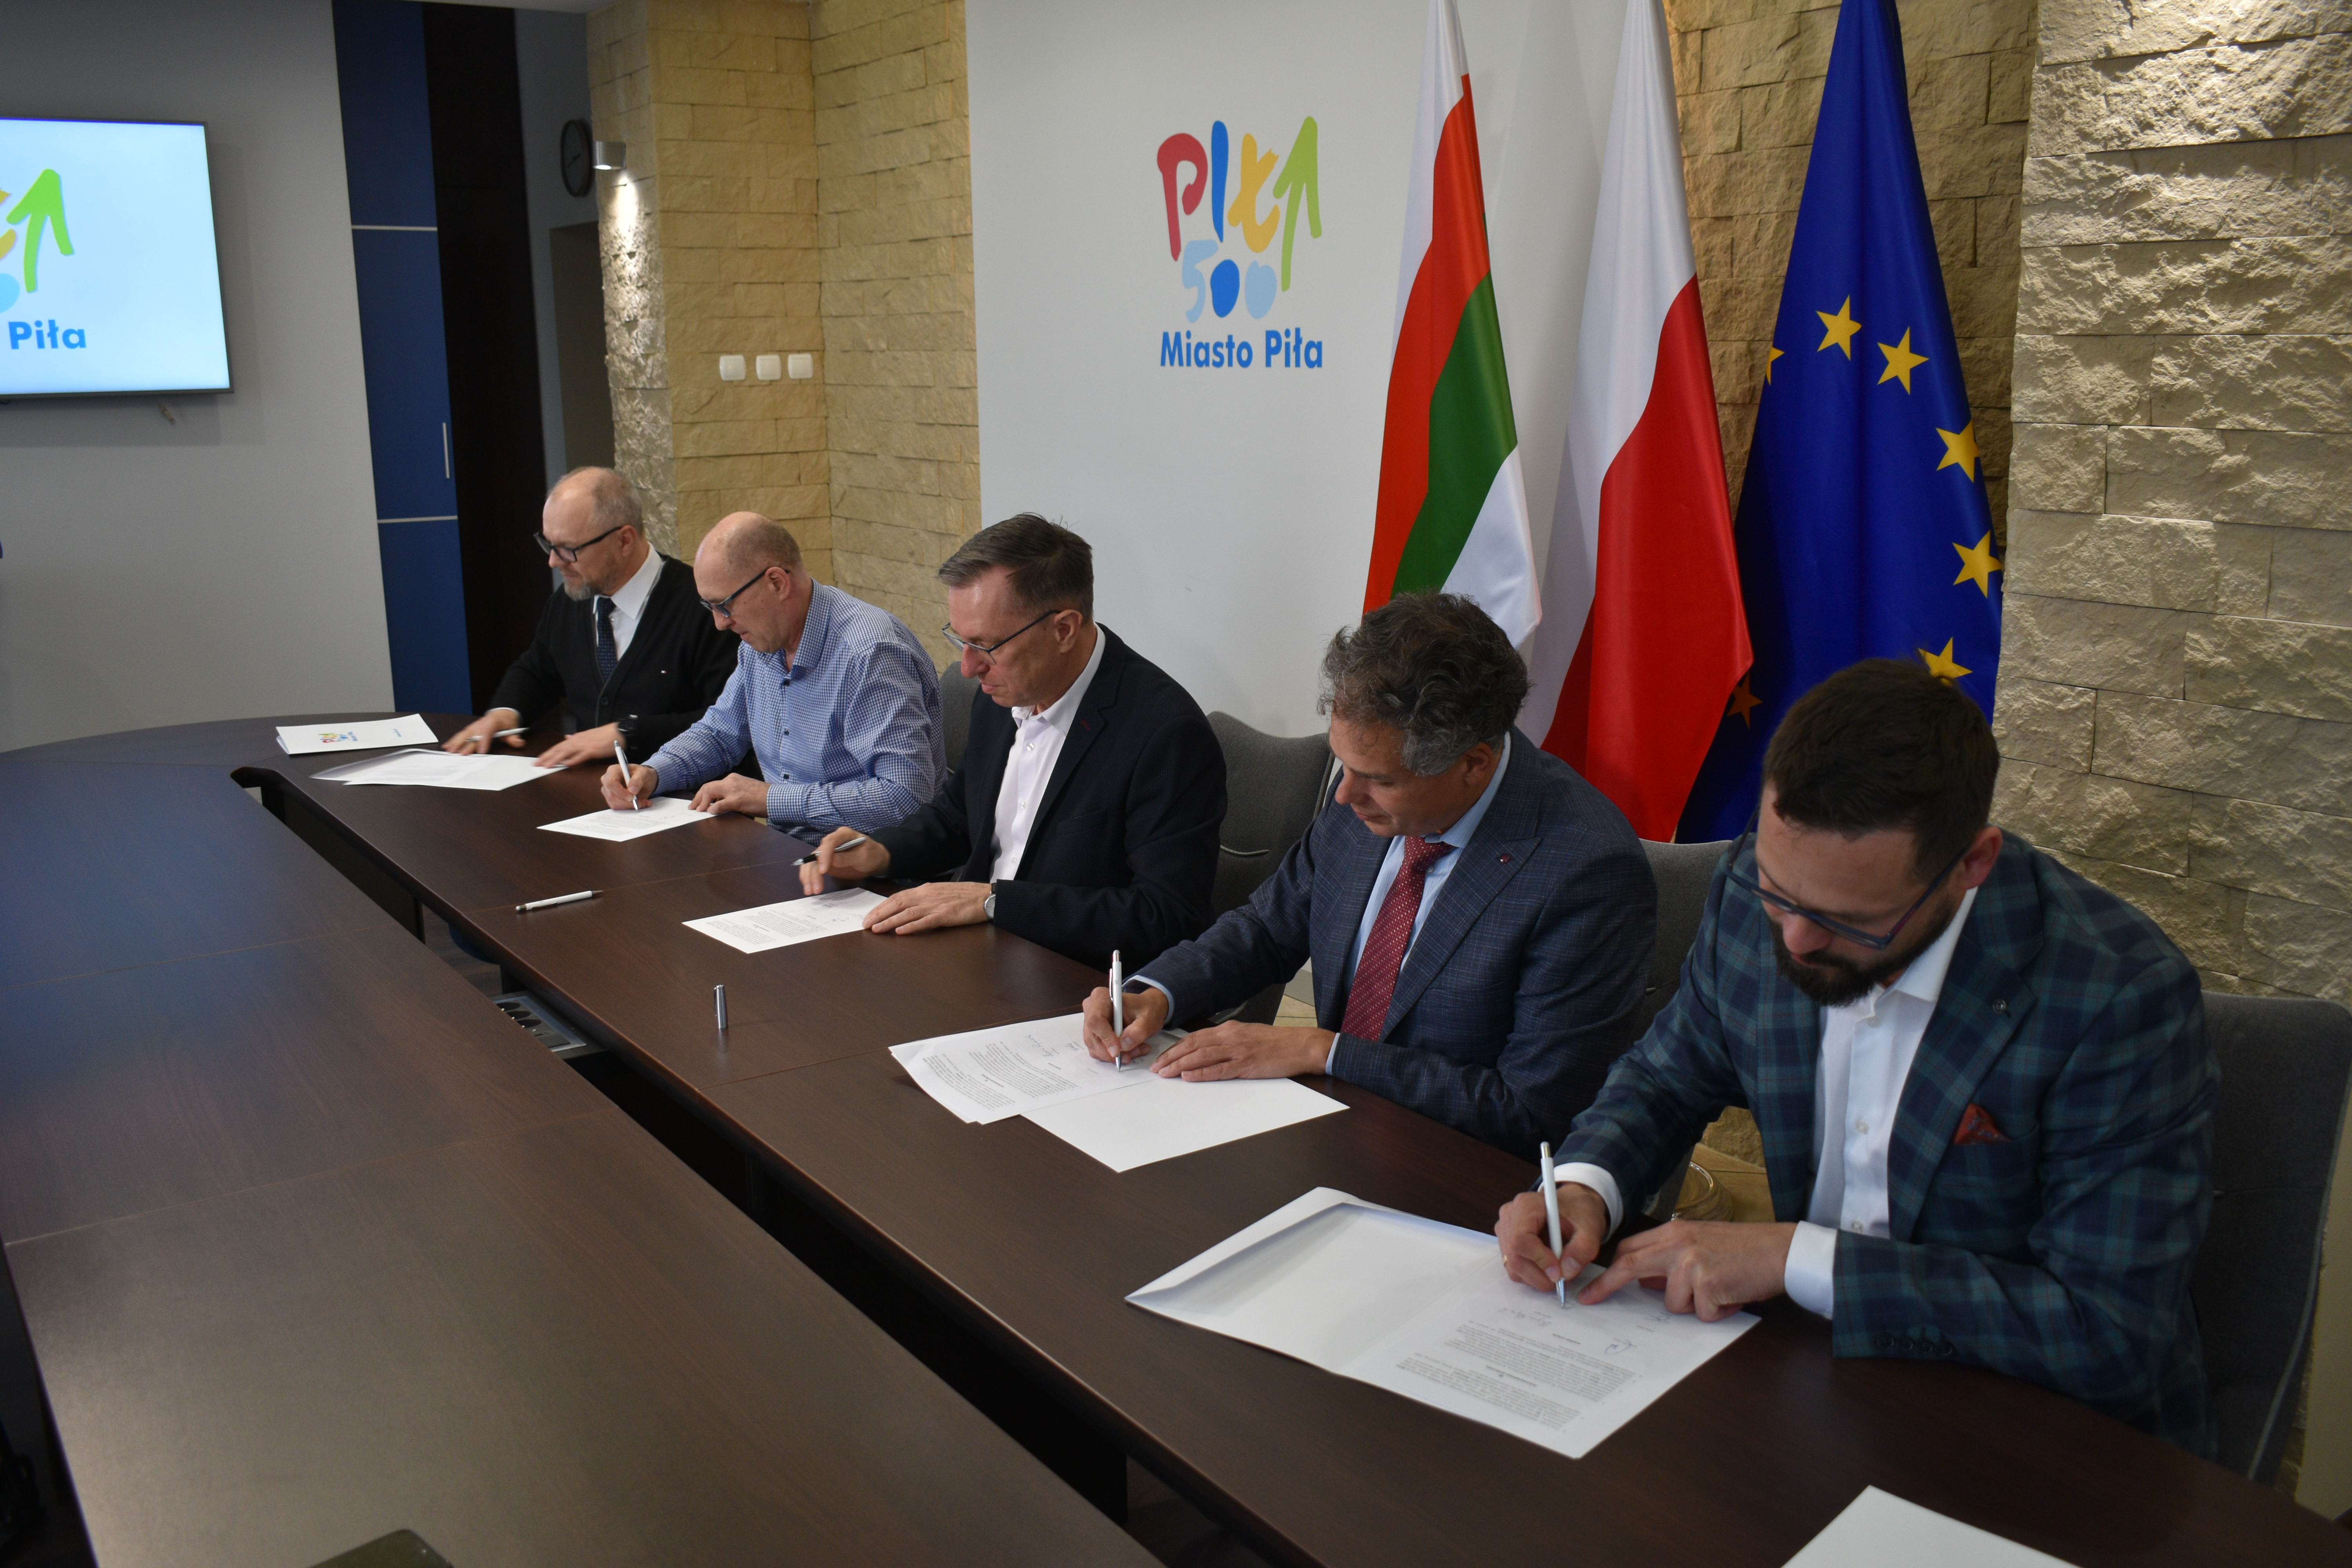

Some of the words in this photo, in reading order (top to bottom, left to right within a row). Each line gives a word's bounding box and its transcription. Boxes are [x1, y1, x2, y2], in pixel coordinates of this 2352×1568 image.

[1182, 240, 1277, 323] 500
[8, 319, 87, 350] Piła
[1160, 330, 1253, 368] Miasto
[1265, 327, 1323, 368] Piła
